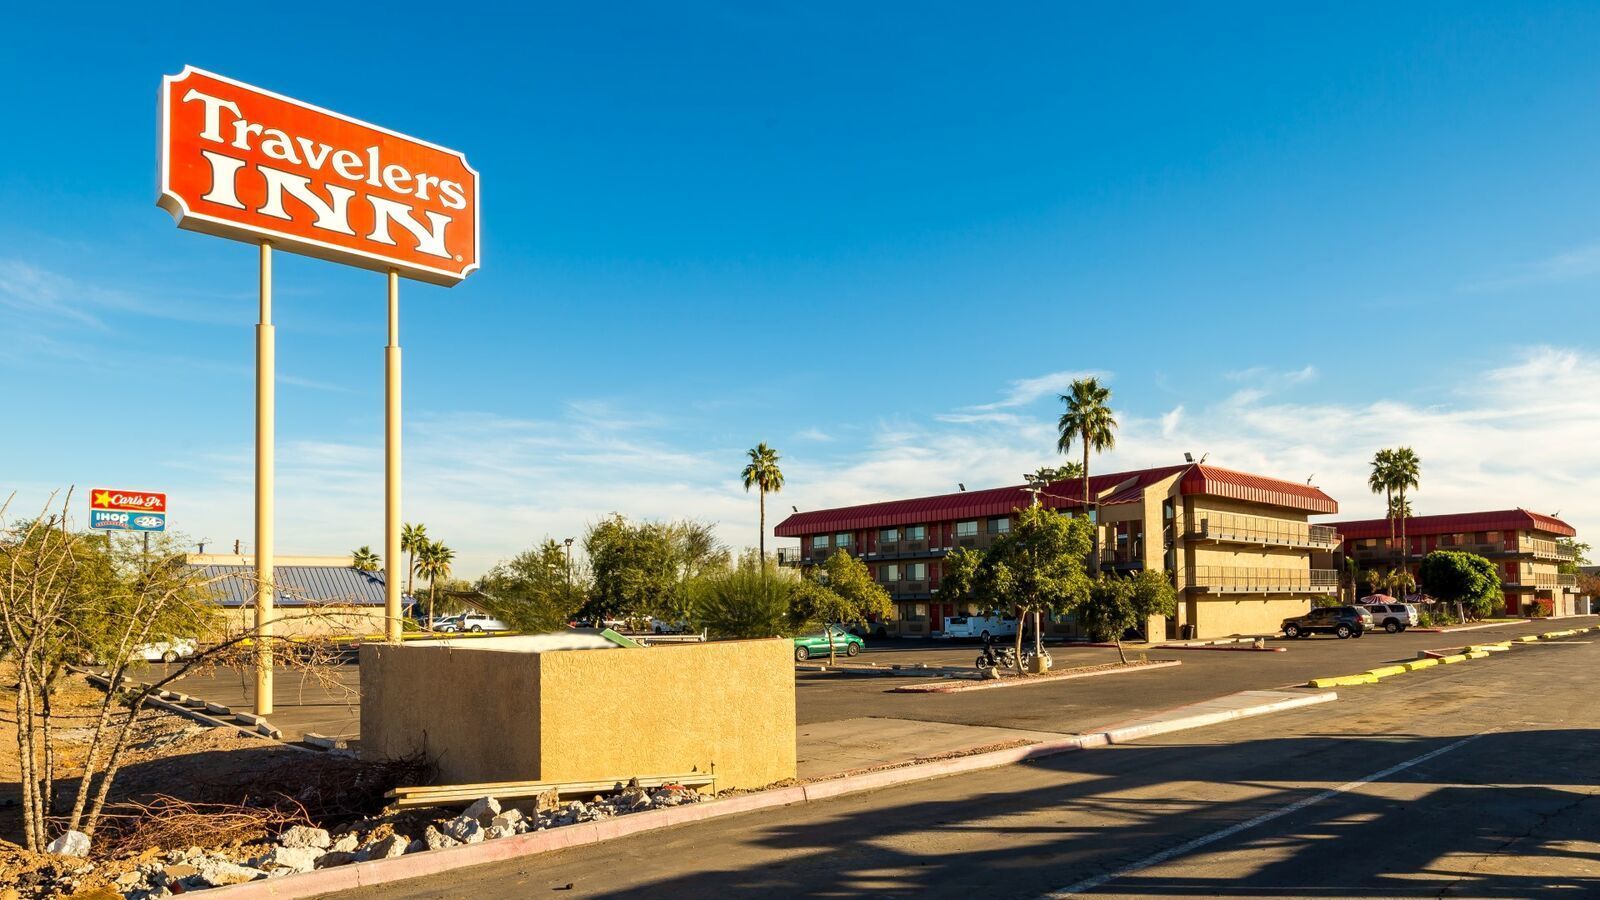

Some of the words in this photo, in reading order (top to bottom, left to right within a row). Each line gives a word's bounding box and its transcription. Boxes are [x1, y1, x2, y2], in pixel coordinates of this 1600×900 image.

[182, 88, 468, 210] Travelers
[200, 150, 454, 260] INN
[96, 512, 129, 524] IHOP
[111, 494, 144, 506] Carl's
[144, 496, 163, 507] Jr.
